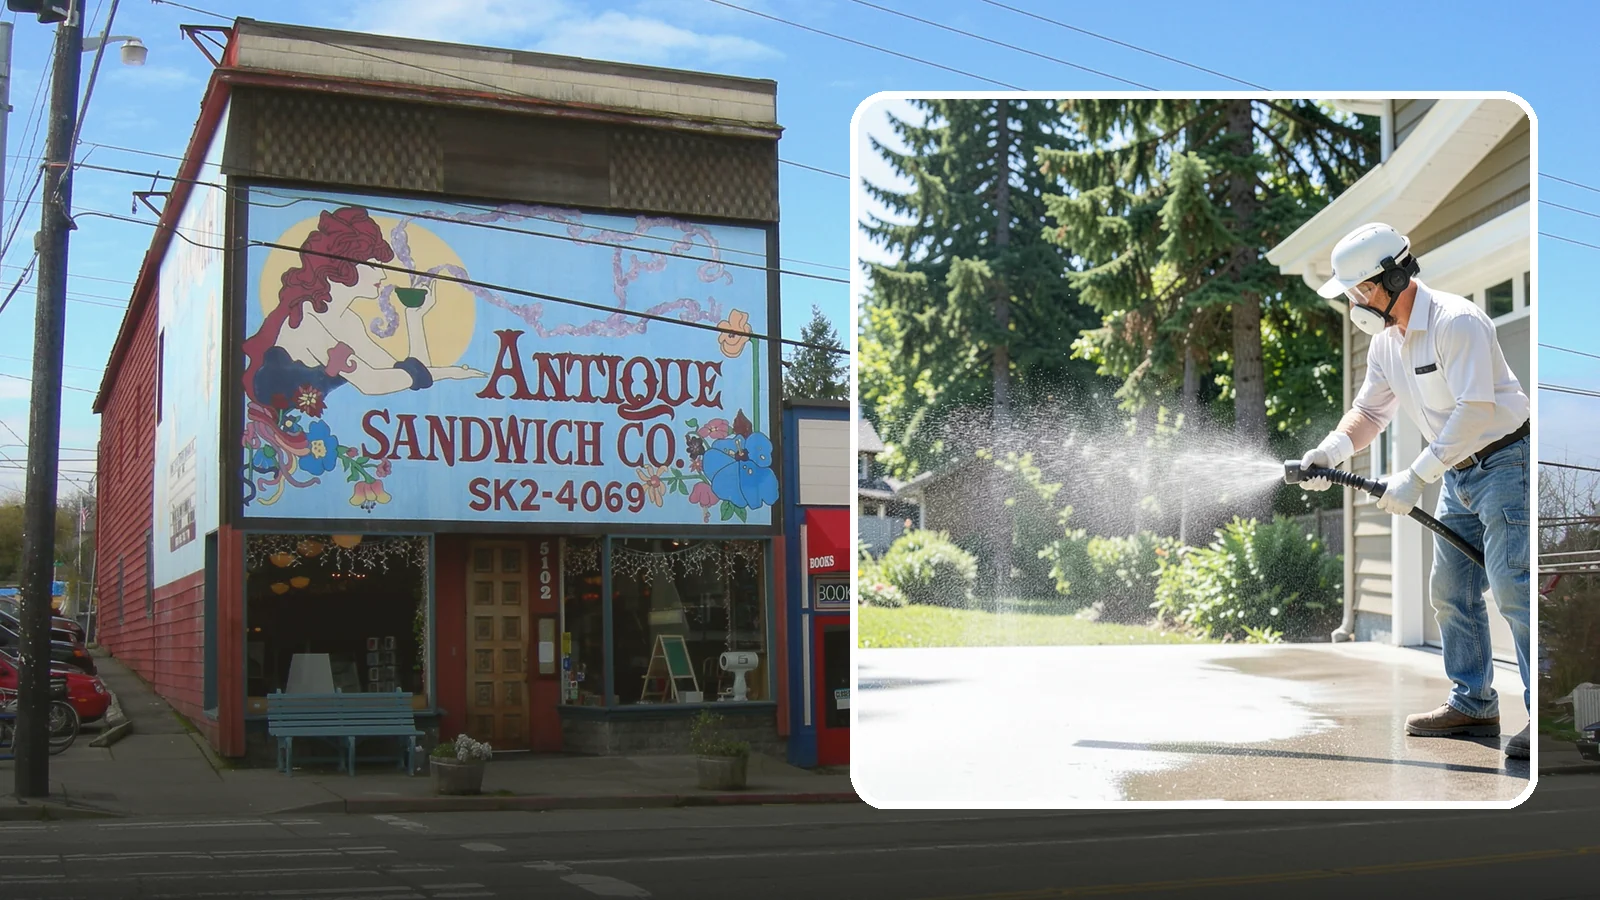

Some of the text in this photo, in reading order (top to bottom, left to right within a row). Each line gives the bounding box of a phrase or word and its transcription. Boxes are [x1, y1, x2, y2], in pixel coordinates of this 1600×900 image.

[361, 408, 685, 469] SANDWICH CO.
[469, 477, 645, 513] SK2-4069
[540, 541, 551, 599] 5102
[809, 555, 834, 569] BOOKS
